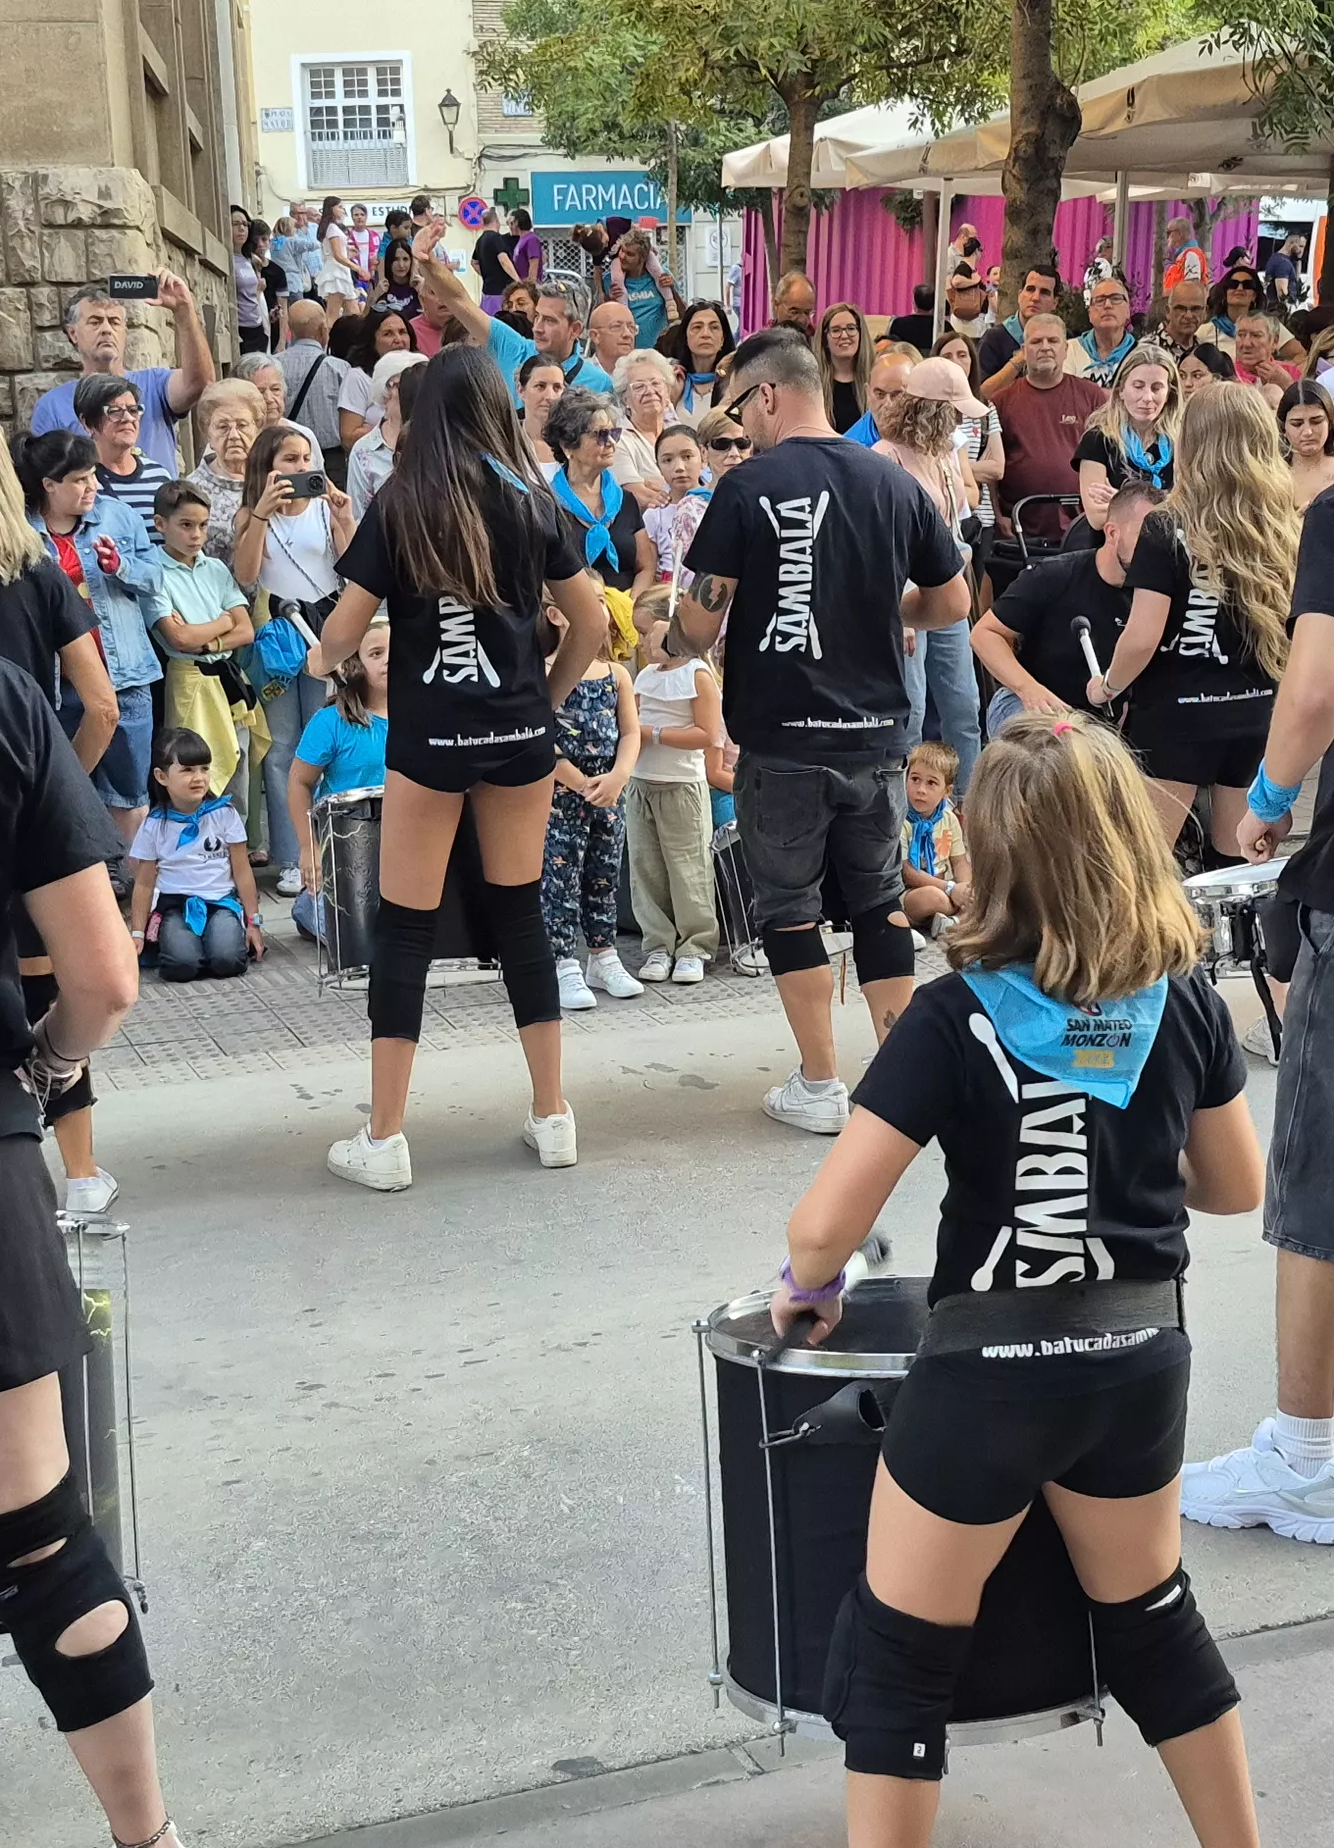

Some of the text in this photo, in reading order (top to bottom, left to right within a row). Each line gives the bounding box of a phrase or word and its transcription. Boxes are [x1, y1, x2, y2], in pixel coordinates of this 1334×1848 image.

[114, 281, 144, 289] DAVID
[1066, 1018, 1133, 1032] SAN MATEO
